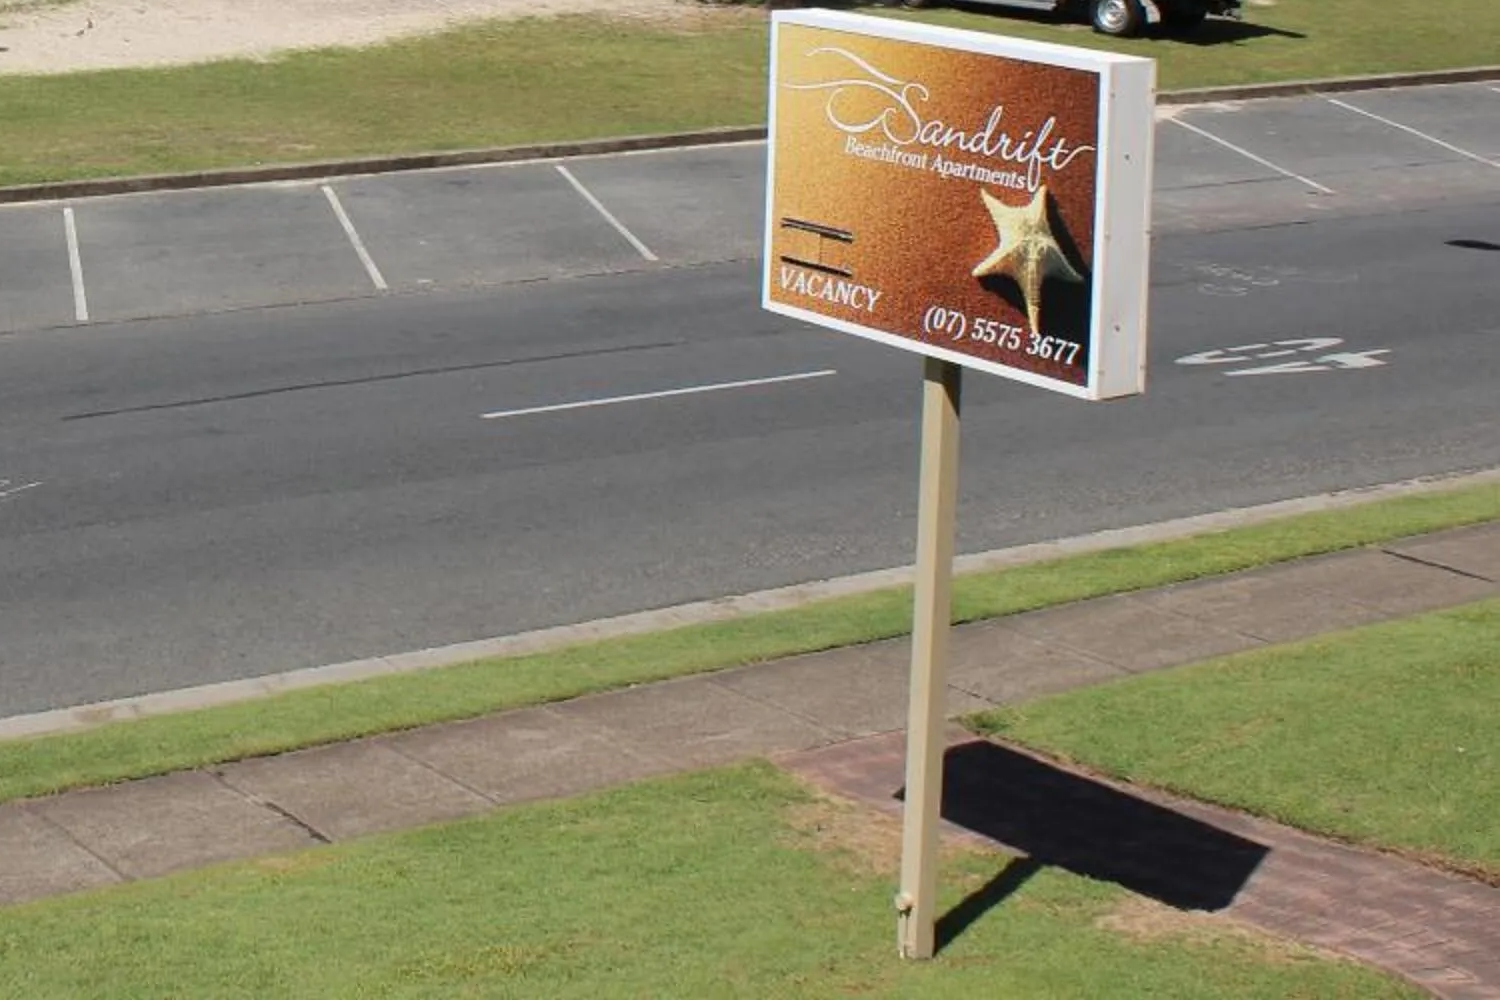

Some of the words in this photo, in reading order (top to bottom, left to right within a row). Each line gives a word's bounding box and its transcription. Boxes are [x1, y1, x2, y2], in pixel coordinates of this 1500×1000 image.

[844, 135, 928, 171] Beachfront
[931, 153, 1027, 190] Apartments
[881, 83, 1096, 193] Sandrift
[780, 265, 883, 313] VACANCY
[923, 305, 968, 341] (07)
[971, 317, 1023, 351] 5575
[1025, 331, 1081, 365] 3677
